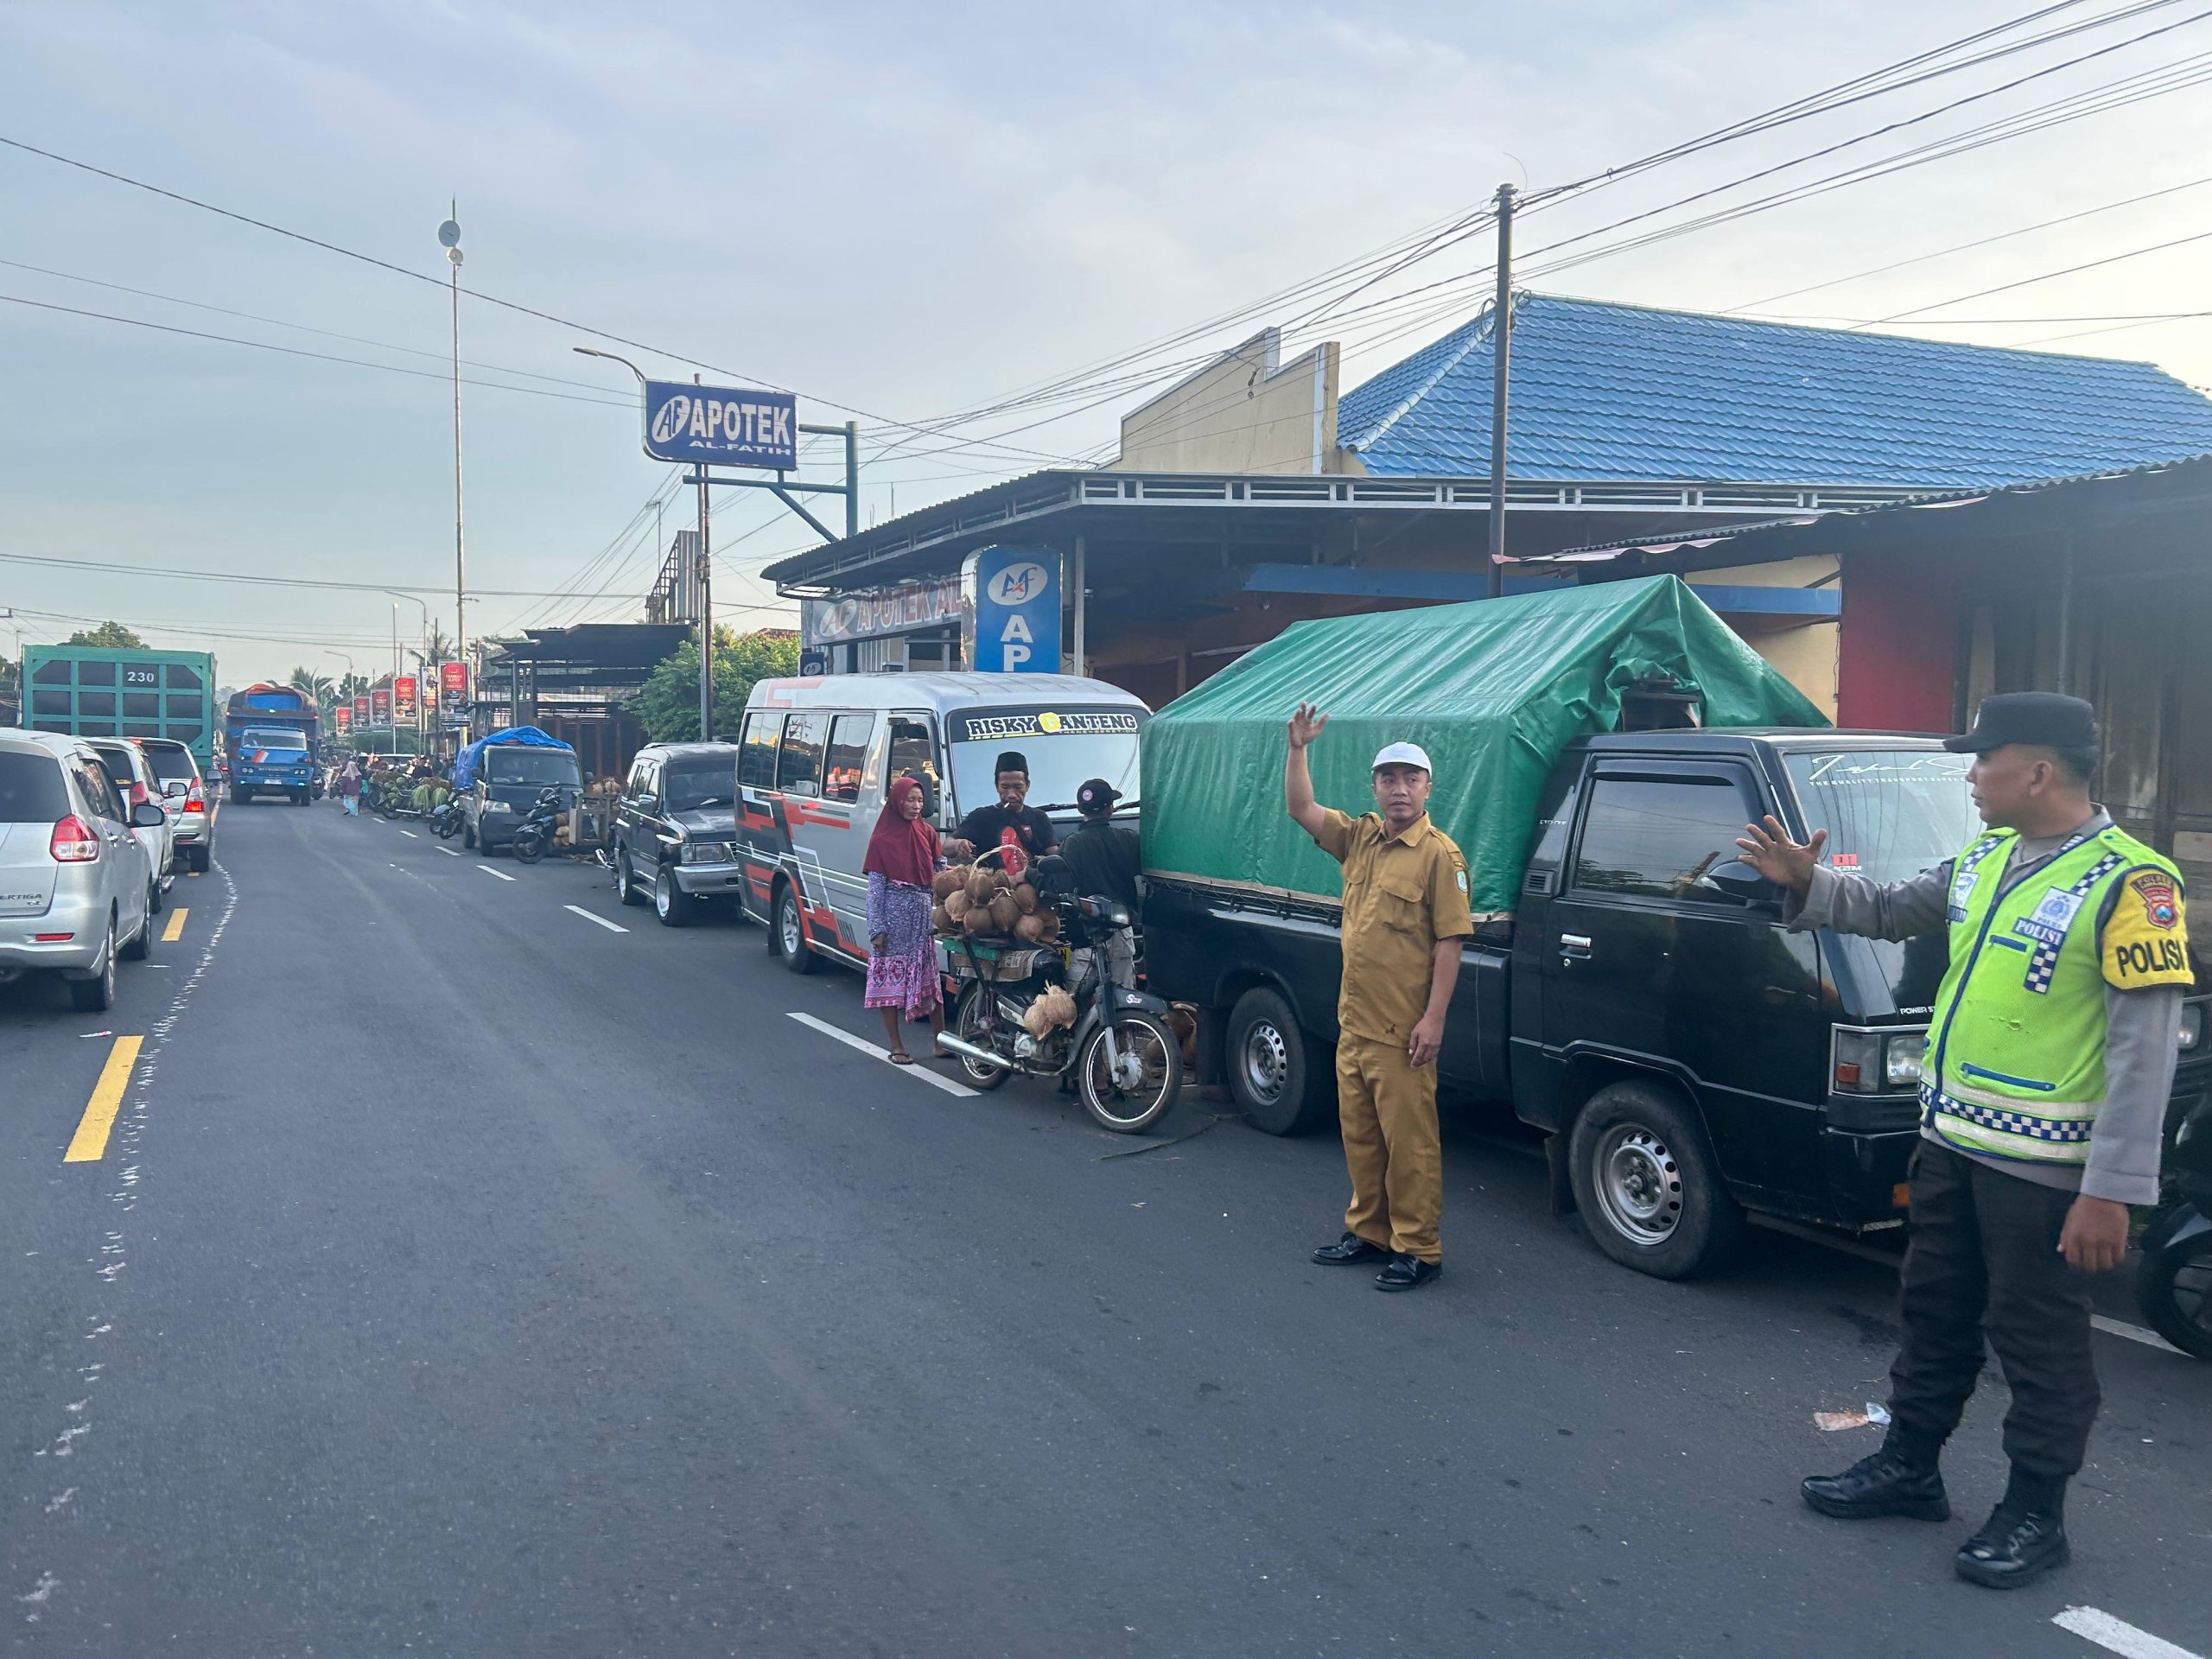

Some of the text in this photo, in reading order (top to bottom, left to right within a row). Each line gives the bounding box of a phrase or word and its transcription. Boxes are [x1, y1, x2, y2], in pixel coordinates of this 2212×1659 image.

[689, 398, 791, 446] APOTEK
[689, 440, 791, 456] AL-FATIH
[856, 579, 932, 632] APOTEK
[127, 671, 154, 683] 230
[965, 712, 1138, 737] RISKY GANTENG
[2014, 919, 2063, 947] POLISI
[2116, 939, 2185, 977] POLISI
